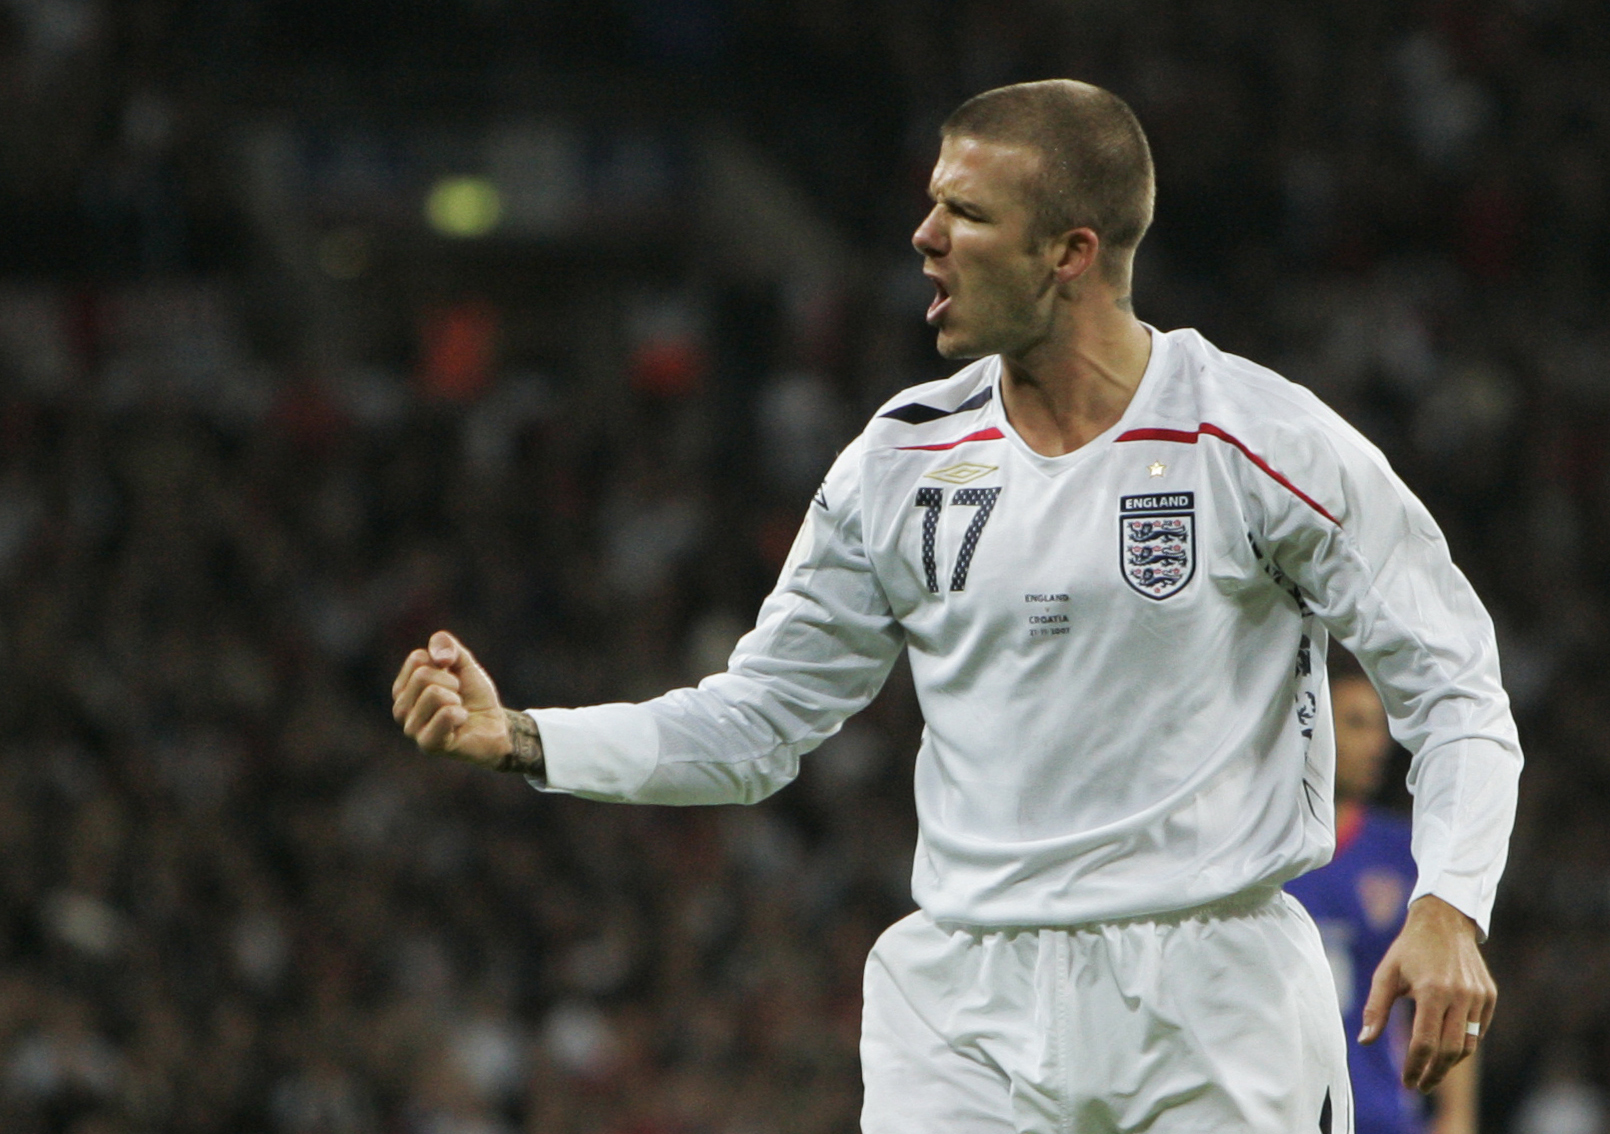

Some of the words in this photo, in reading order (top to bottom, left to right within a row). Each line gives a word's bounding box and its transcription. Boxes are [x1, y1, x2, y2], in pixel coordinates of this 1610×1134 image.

[1125, 495, 1188, 509] ENGLAND
[914, 486, 1002, 593] 17
[1025, 594, 1069, 602] ENGLAND
[1029, 615, 1069, 624] CROATIA
